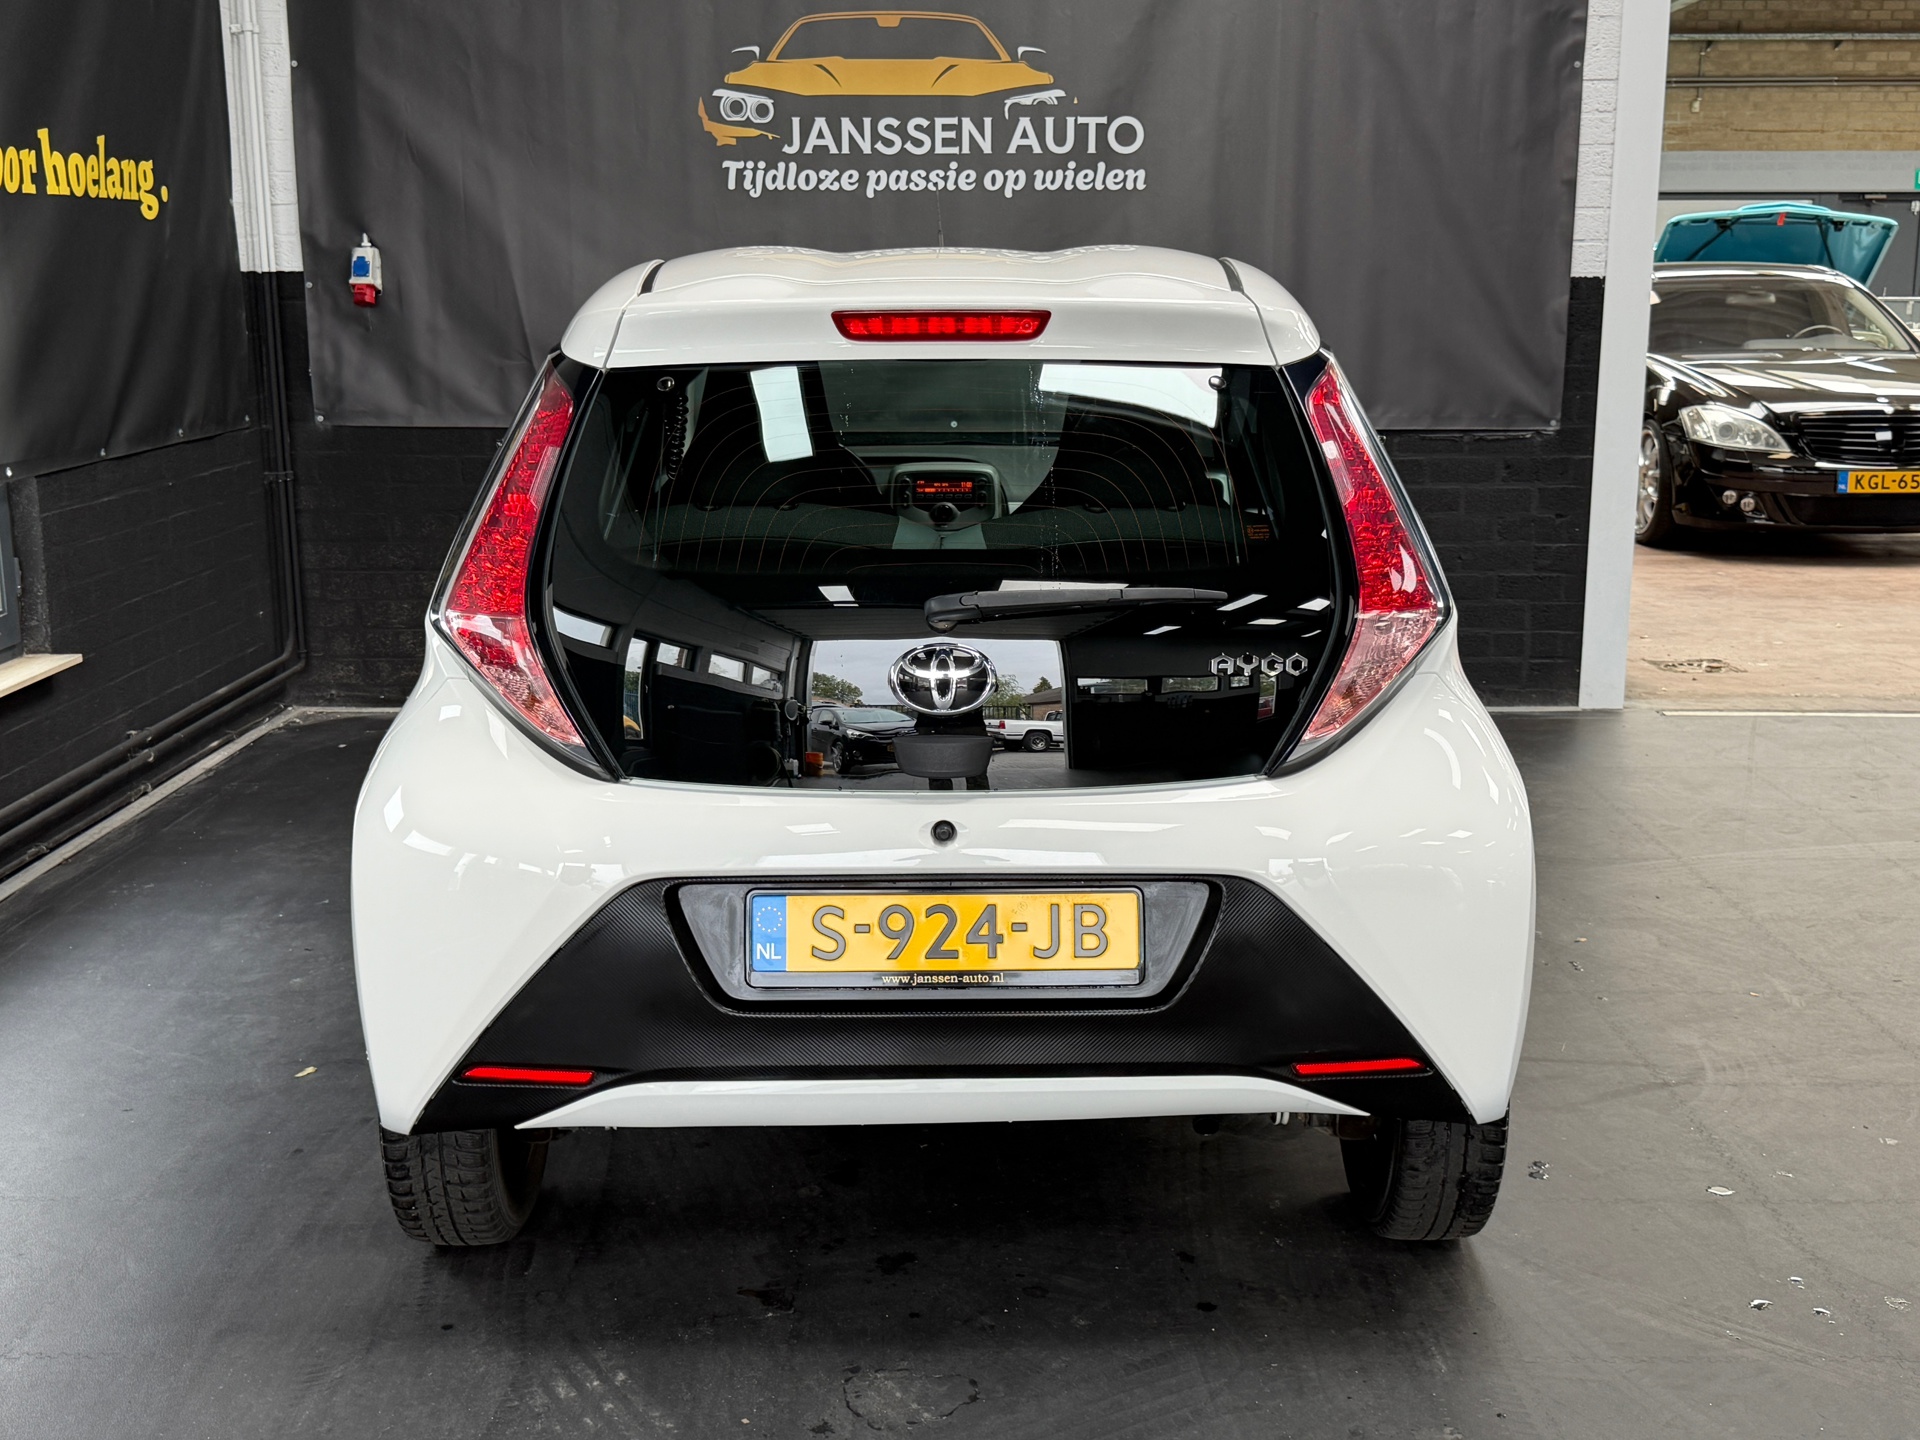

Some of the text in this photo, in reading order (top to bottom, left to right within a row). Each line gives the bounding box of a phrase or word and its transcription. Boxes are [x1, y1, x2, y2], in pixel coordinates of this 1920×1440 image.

[782, 115, 1145, 155] JANSSEN AUTO
[0, 127, 169, 220] or hoelang.
[721, 160, 1147, 198] Tijdloze passie op wielen
[1854, 474, 1920, 490] KGL-65
[1210, 652, 1308, 676] AYGO
[811, 903, 1110, 961] S-924-JB
[756, 943, 782, 959] NL
[881, 972, 1004, 986] www.janssen-auto.nl
